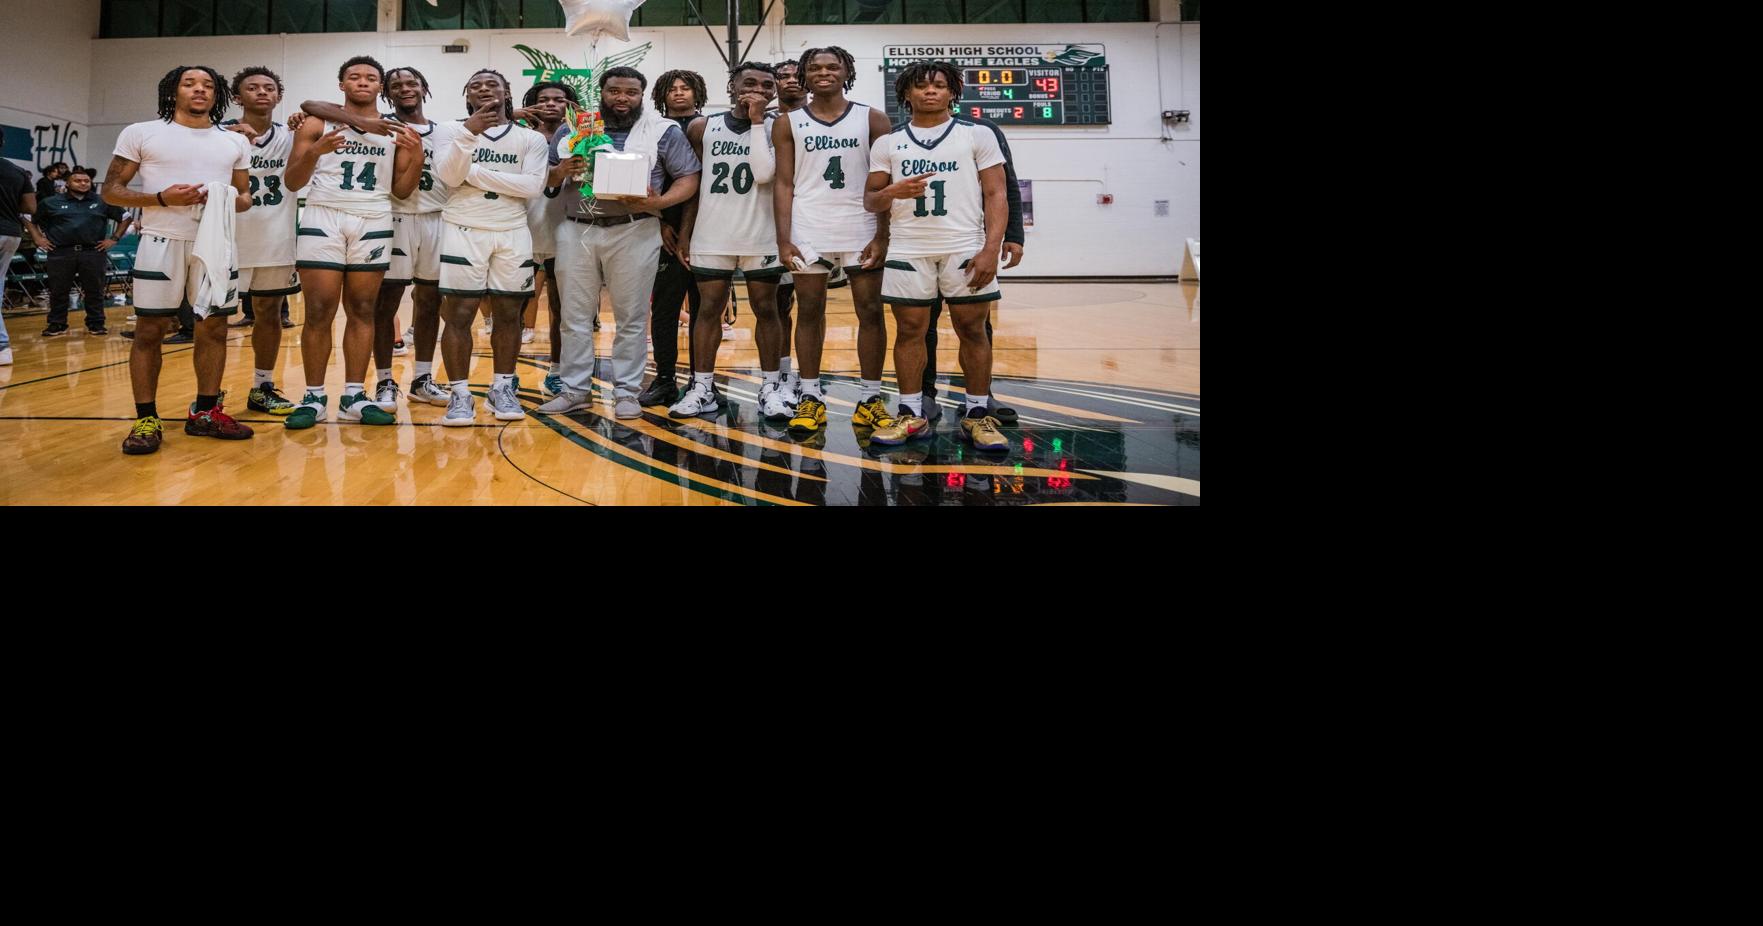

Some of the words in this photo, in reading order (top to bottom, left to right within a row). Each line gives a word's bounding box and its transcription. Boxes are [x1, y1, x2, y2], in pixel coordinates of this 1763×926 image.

[889, 47, 944, 56] ELLISON
[949, 47, 982, 55] HIGH
[988, 46, 1042, 55] SCHOOL
[956, 58, 983, 66] THE
[987, 58, 1040, 66] EAGLES
[978, 70, 1013, 84] 0.0
[1029, 69, 1060, 77] VISITOR
[1035, 78, 1059, 92] 43
[1003, 88, 1013, 99] 4
[971, 107, 981, 118] 3
[1014, 107, 1024, 118] 2
[1043, 107, 1052, 118] 8
[711, 140, 750, 156] Elliso
[804, 135, 860, 152] Ellison
[822, 155, 845, 190] 4
[901, 159, 960, 177] Ellison
[339, 161, 377, 191] 14
[710, 162, 755, 194] 20
